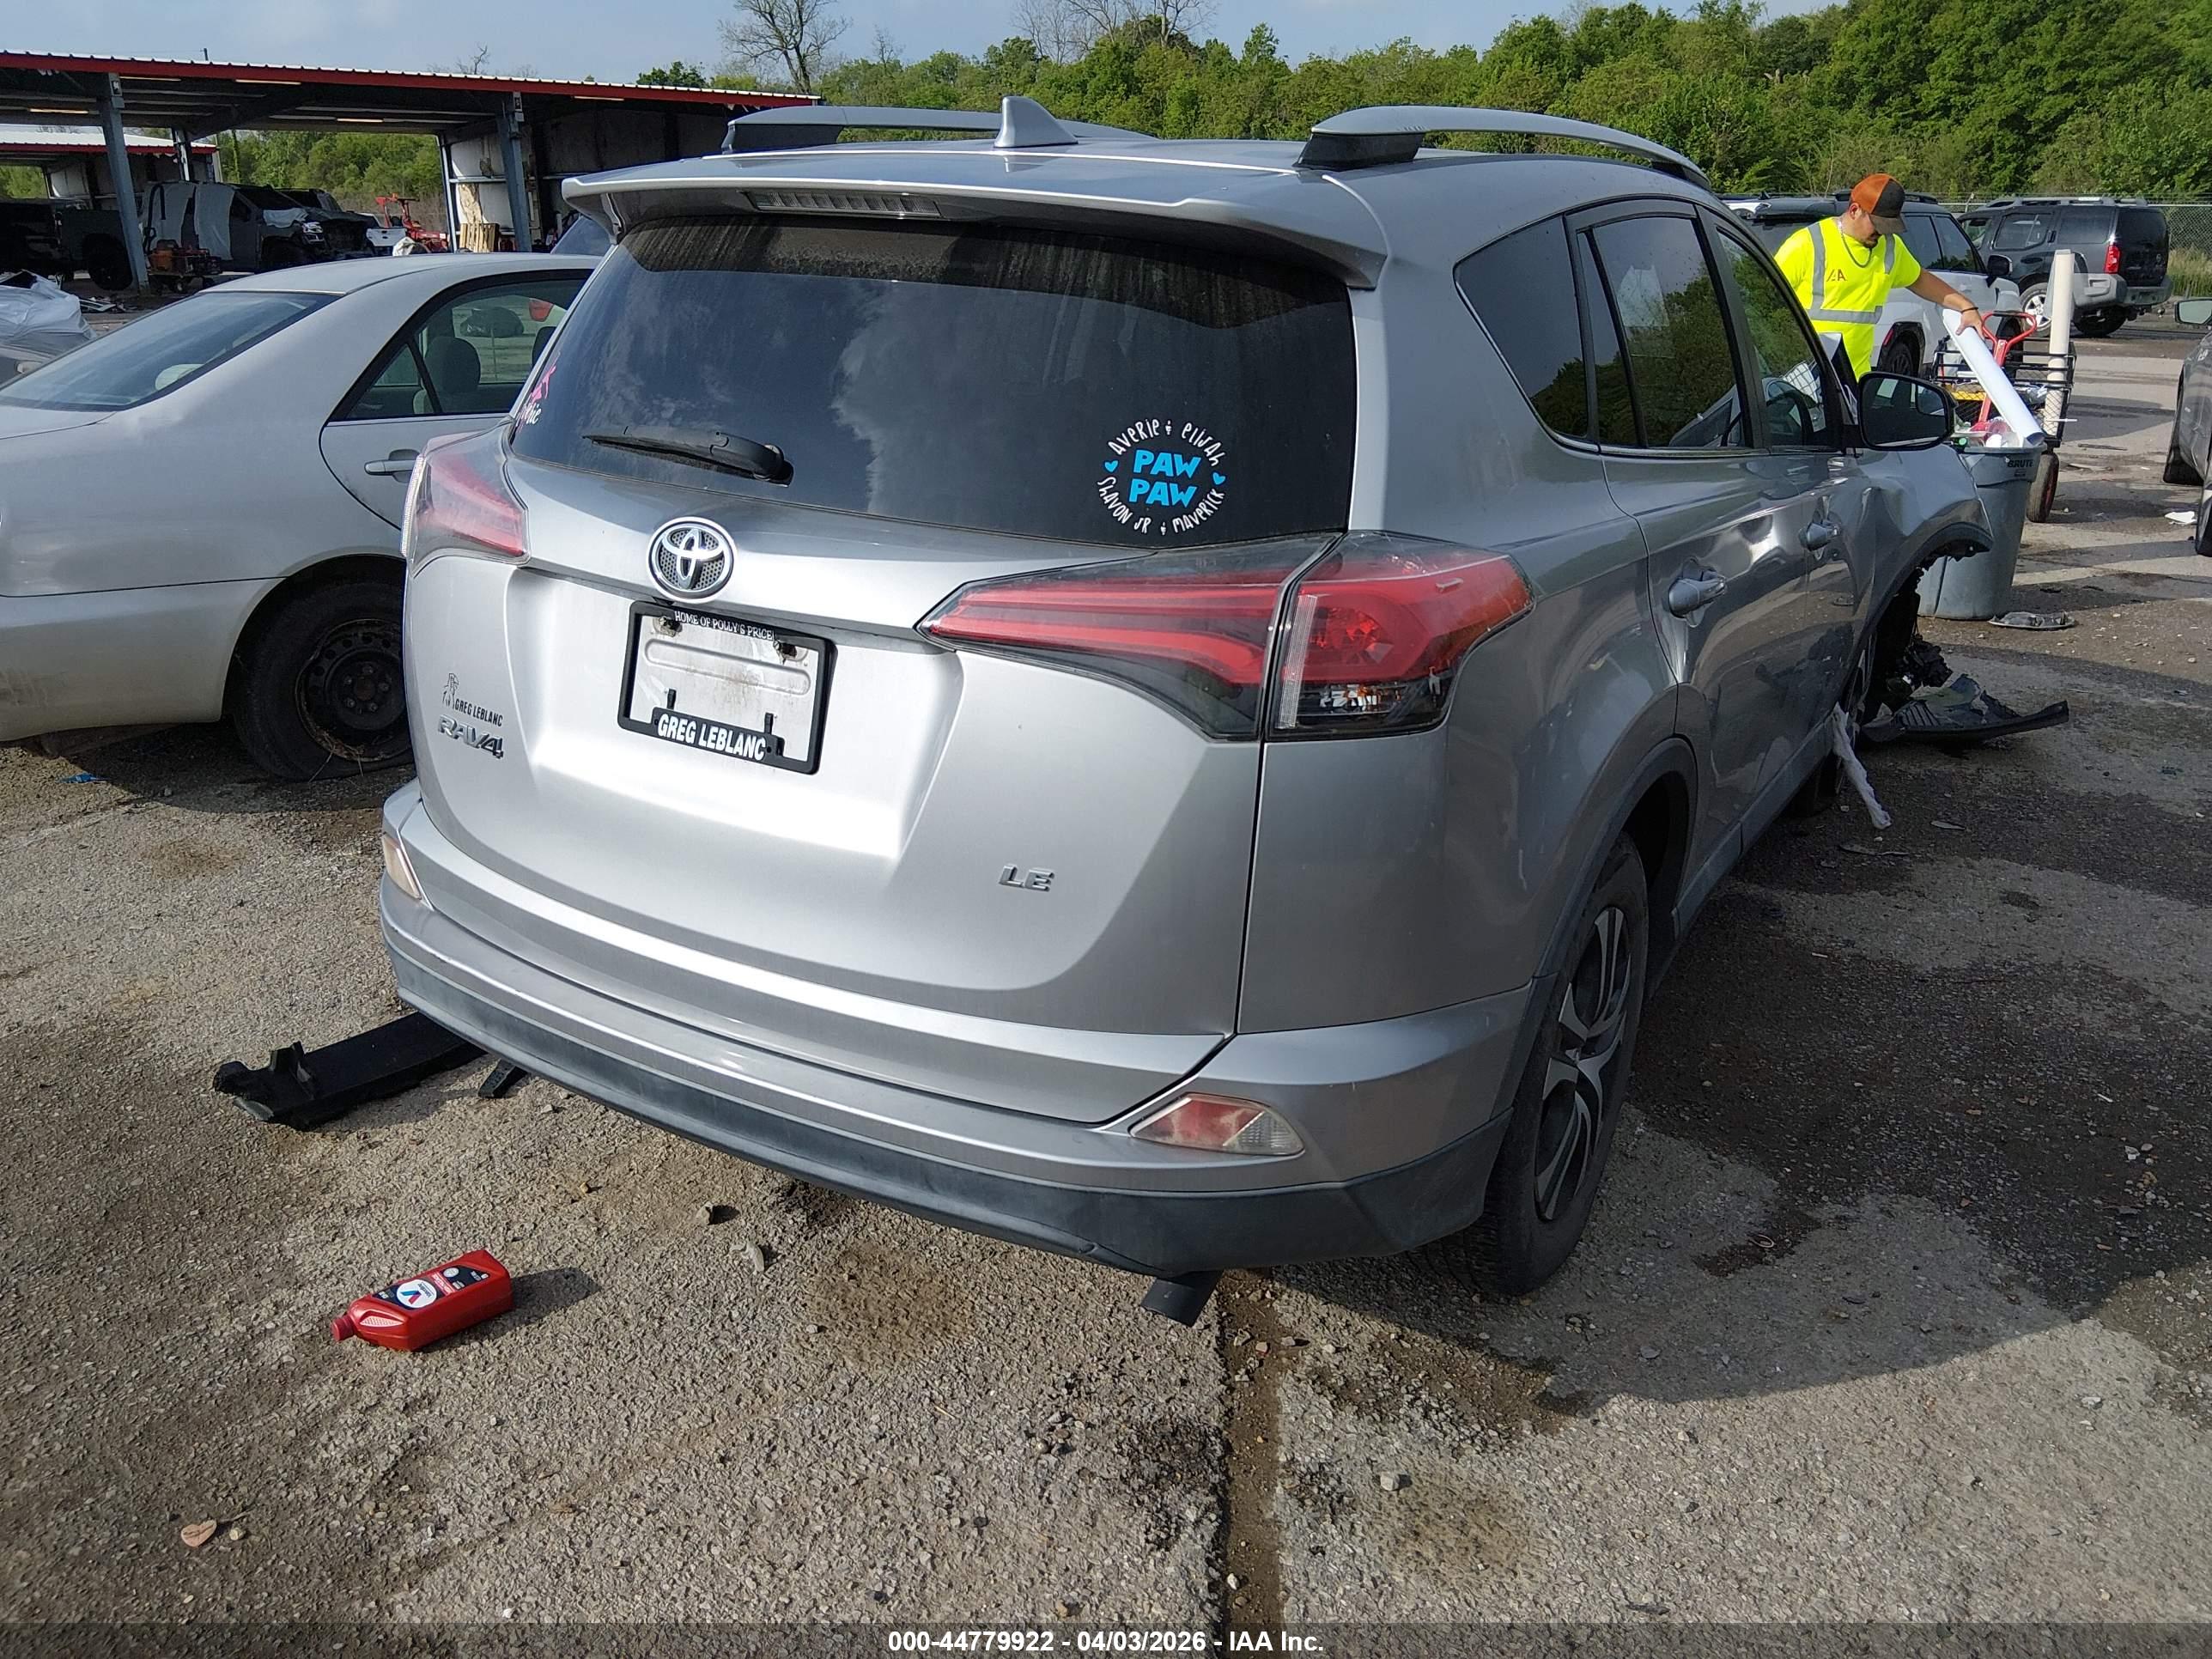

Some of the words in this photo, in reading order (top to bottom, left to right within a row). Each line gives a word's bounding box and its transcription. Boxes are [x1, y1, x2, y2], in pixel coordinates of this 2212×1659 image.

[1133, 449, 1201, 478] PAW
[2008, 459, 2034, 468] BRUTE
[1128, 478, 1197, 507] PAW
[1133, 517, 1152, 534] JR
[675, 611, 699, 626] HOME
[700, 616, 711, 628] OF
[712, 618, 745, 635] POLLY'S
[455, 698, 473, 715] GREG
[472, 704, 503, 727] LEBLANC
[438, 714, 504, 759] RAV4
[658, 713, 696, 744] GREG
[698, 723, 767, 761] LEBLANC
[999, 864, 1054, 892] LE
